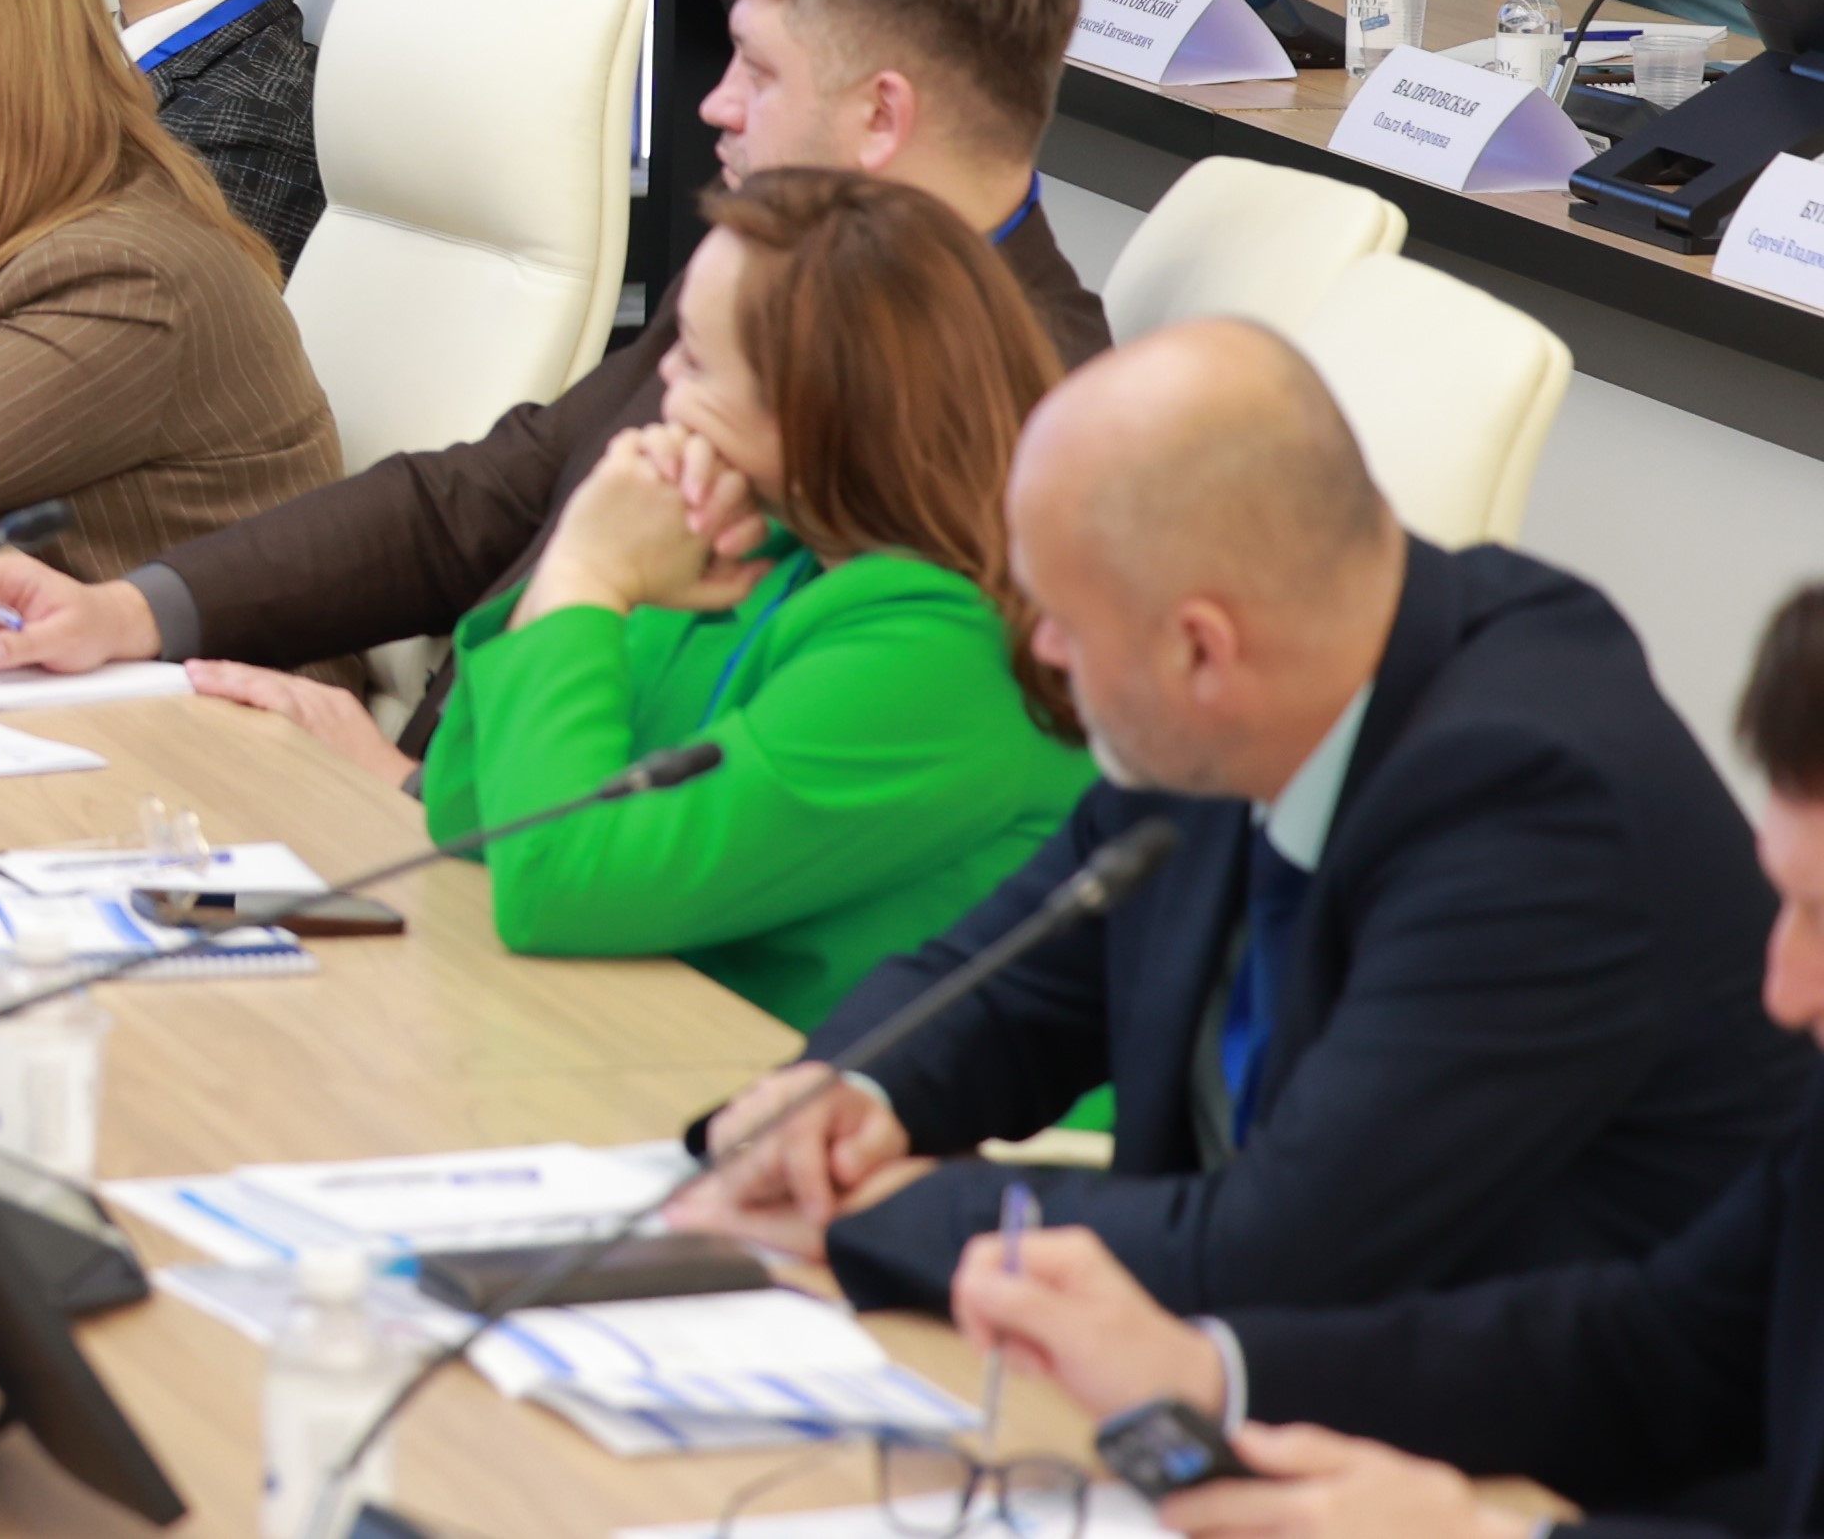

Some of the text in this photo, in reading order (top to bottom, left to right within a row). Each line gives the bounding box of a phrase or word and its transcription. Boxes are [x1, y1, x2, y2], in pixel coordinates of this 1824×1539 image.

[1103, 22, 1155, 49] Евгеньевич
[1392, 78, 1481, 118] ВАЛЯРОВСКАЯ
[1373, 111, 1451, 149] Ольга Федоровна
[1748, 227, 1786, 253] Сергей
